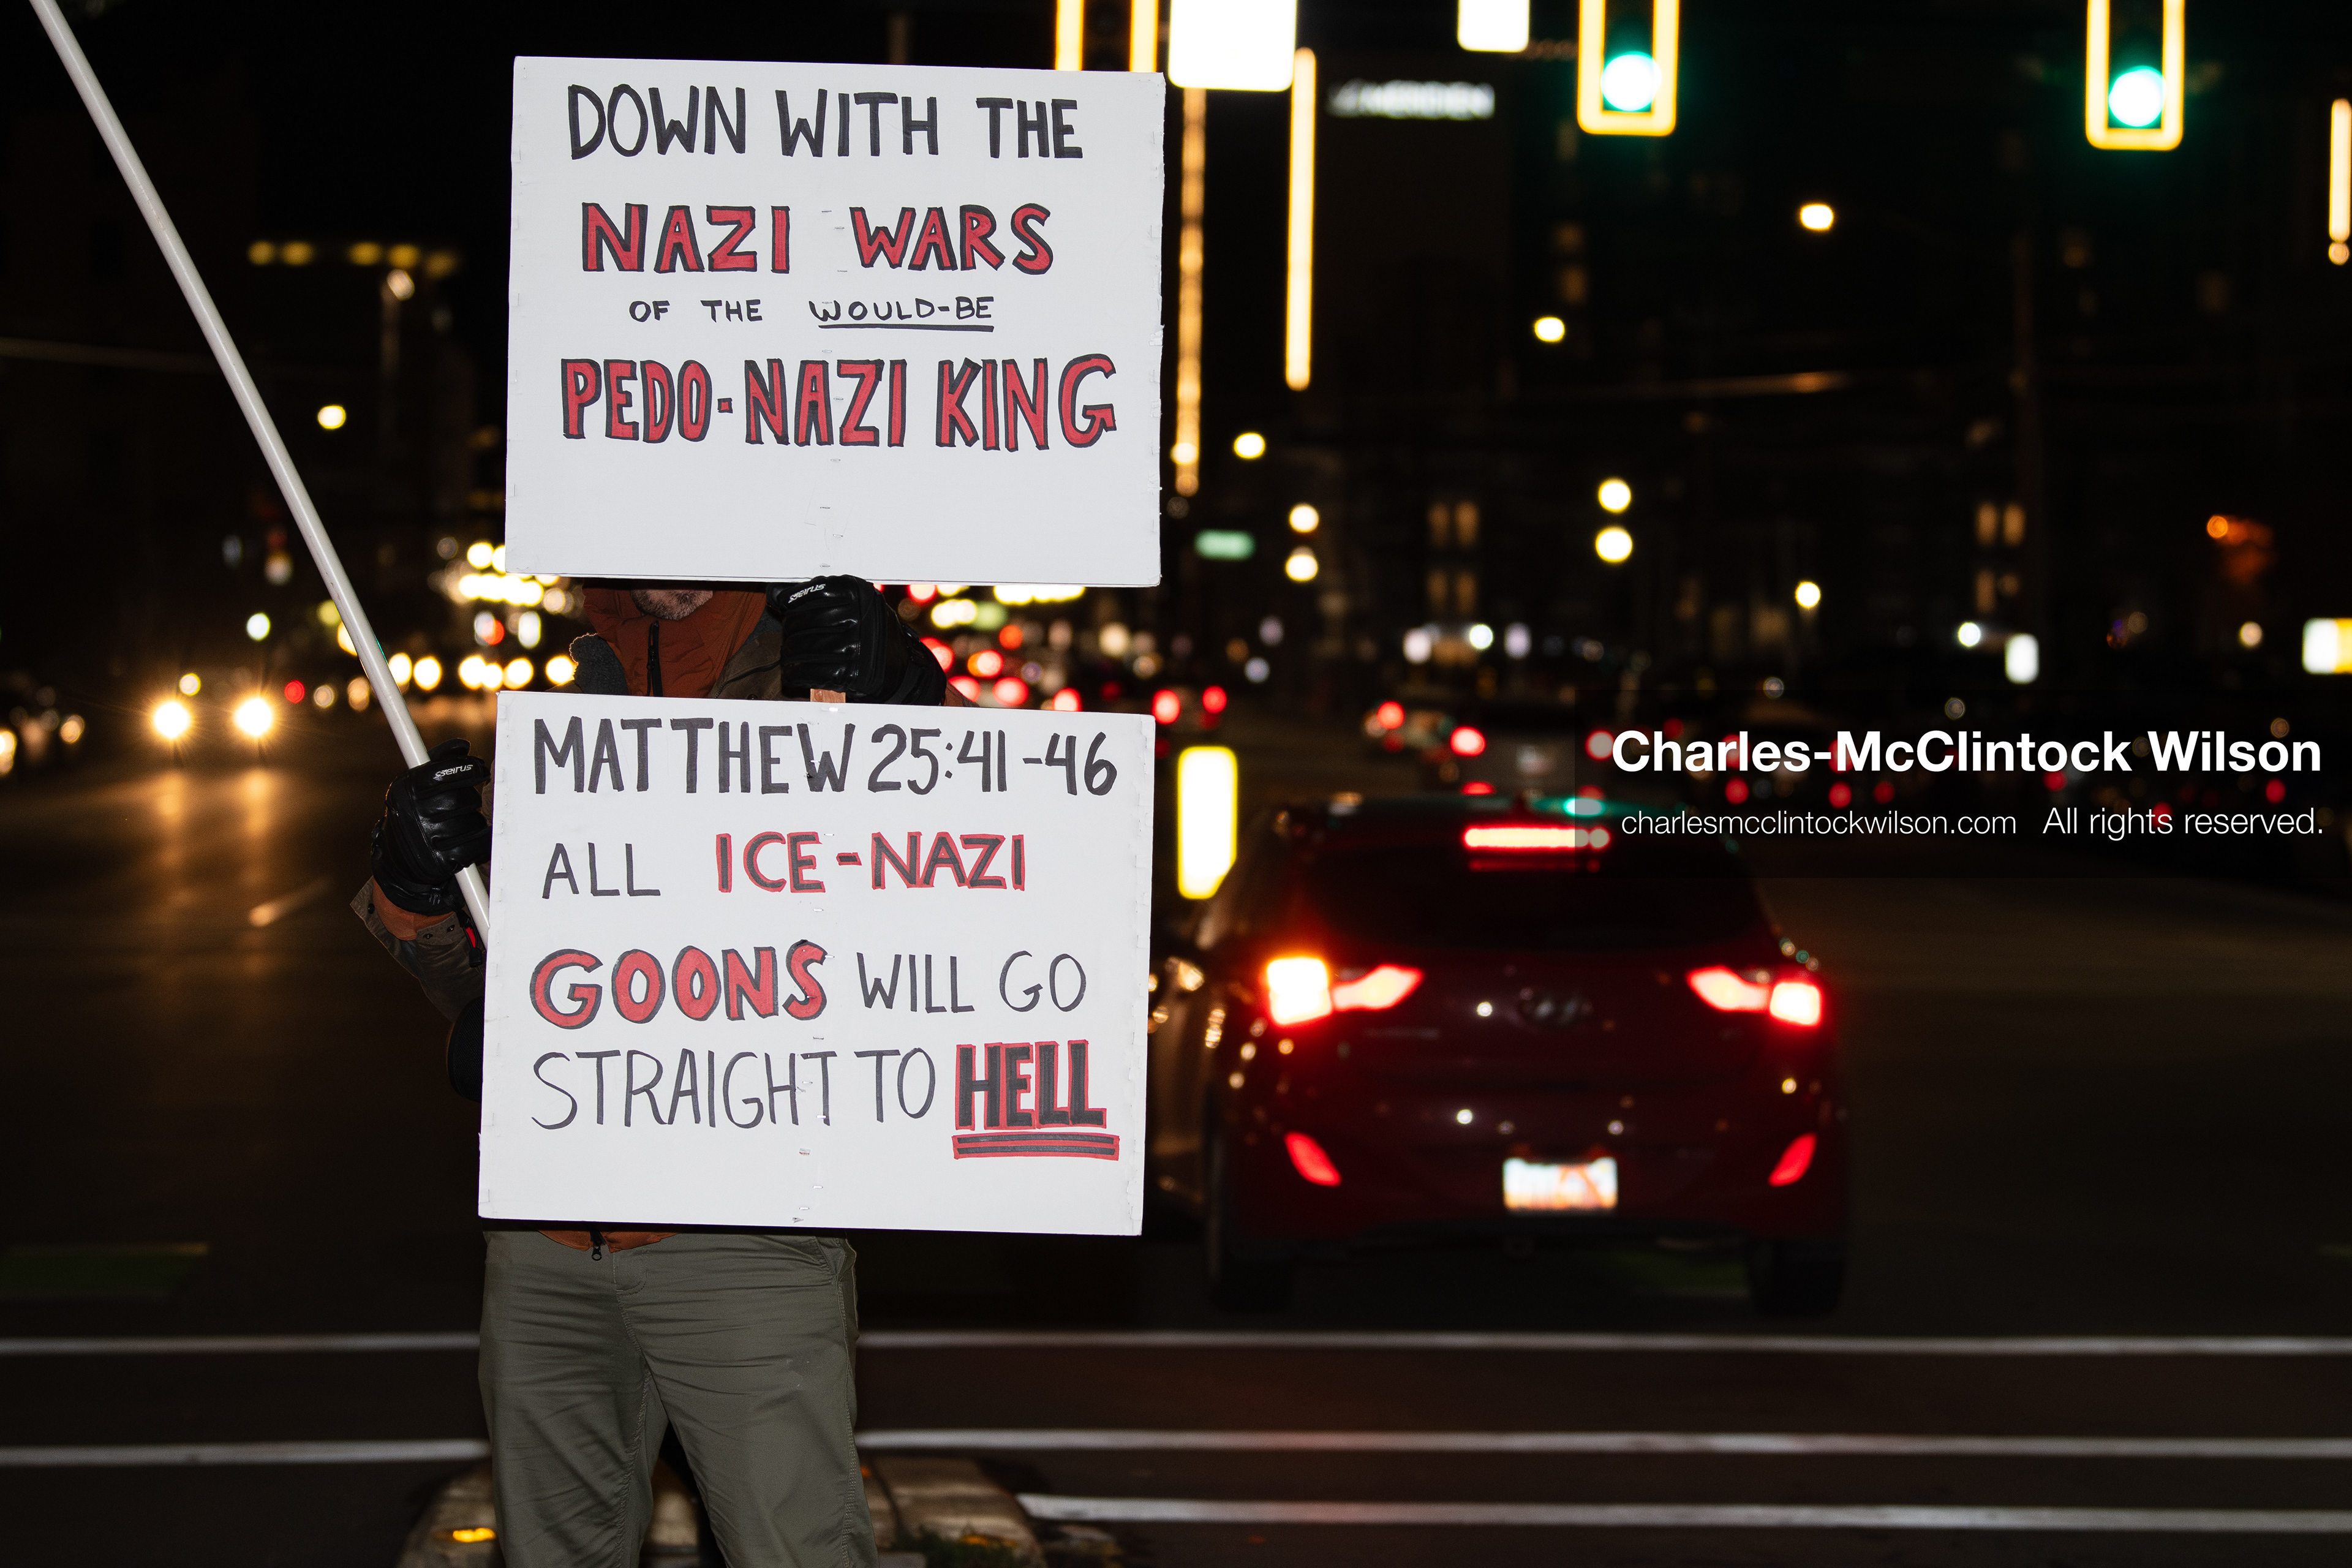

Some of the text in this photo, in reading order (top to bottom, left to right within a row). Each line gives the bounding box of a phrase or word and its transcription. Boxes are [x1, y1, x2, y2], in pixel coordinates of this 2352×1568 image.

[568, 84, 1082, 160] DOWN WITH THE
[582, 202, 1053, 274] NAZI WARS
[630, 296, 994, 323] OF THE WOULD-BE
[936, 354, 1117, 452] KING
[535, 716, 855, 794] MATTHEW
[543, 832, 1025, 899] ALL ICE-NAZI
[530, 940, 1086, 1029] GOONS WILL GO
[532, 1040, 1107, 1131] STRAIGHT TO HELL
